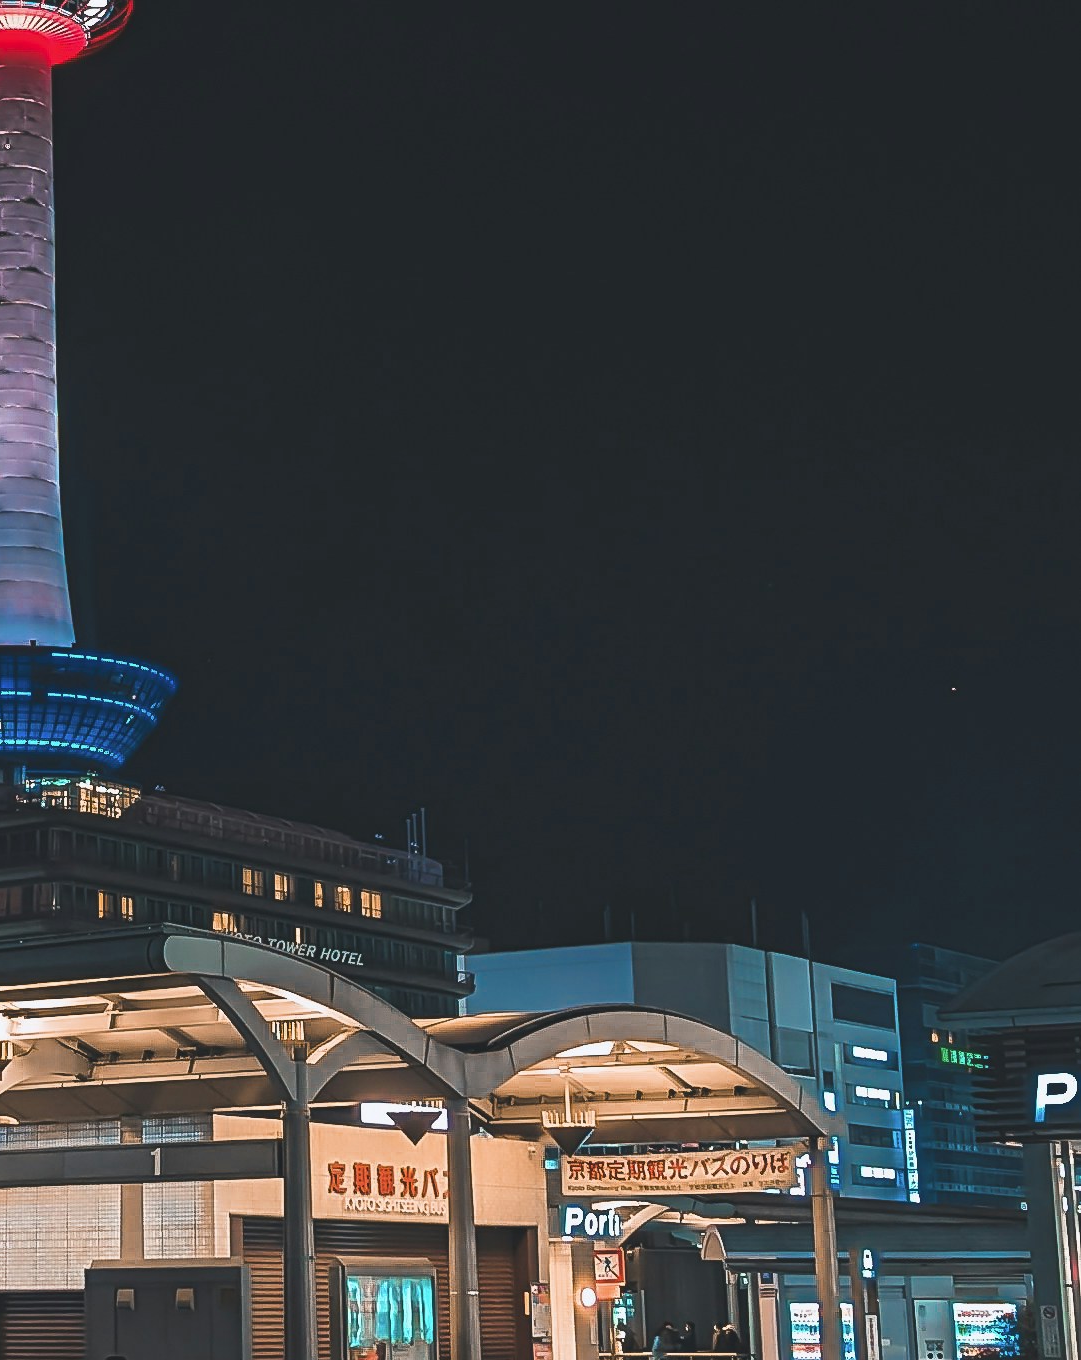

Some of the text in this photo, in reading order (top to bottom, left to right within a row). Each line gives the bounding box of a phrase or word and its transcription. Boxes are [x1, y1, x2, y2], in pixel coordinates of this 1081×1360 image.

[319, 947, 365, 967] HOTEL
[1034, 1072, 1079, 1123] P
[150, 1147, 161, 1176] 1
[566, 1150, 791, 1181] 京都定期観光バスのりば
[345, 1198, 376, 1212] KYOTO
